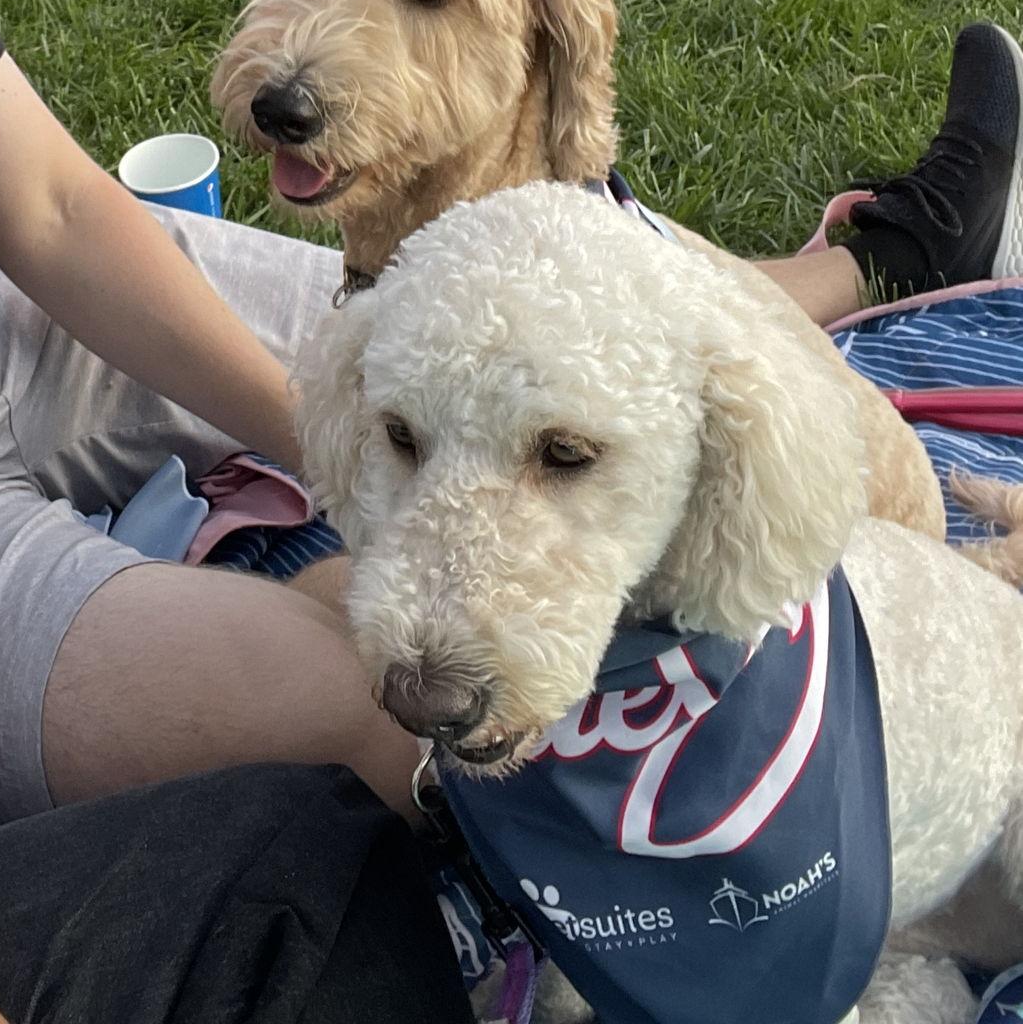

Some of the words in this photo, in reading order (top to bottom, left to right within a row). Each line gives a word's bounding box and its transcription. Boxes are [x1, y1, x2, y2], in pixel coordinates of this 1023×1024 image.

[762, 851, 837, 909] NOAH'S
[584, 940, 623, 953] STAY
[638, 932, 677, 946] PLAY
